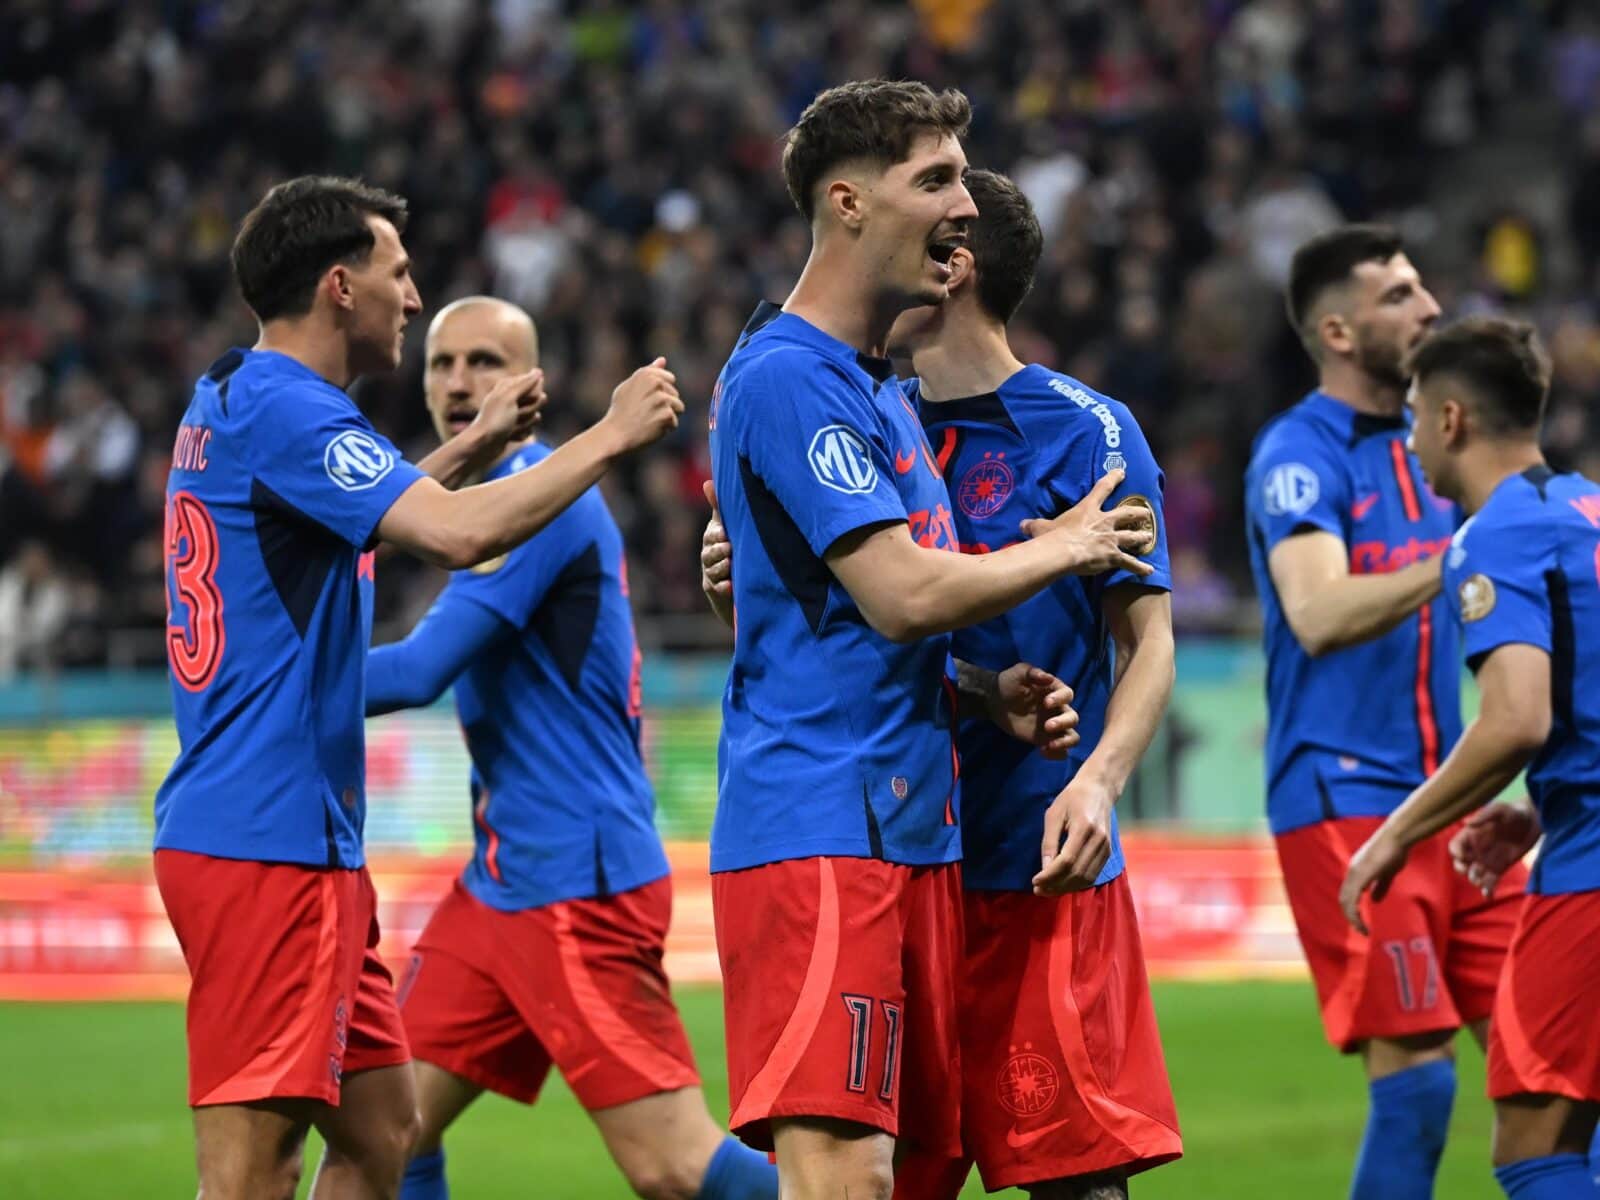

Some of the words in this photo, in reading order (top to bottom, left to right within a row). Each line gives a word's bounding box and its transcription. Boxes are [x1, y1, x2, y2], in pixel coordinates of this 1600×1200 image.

[329, 433, 389, 486] MG
[813, 430, 875, 490] MG
[1383, 936, 1438, 1010] 17
[841, 992, 901, 1103] 11
